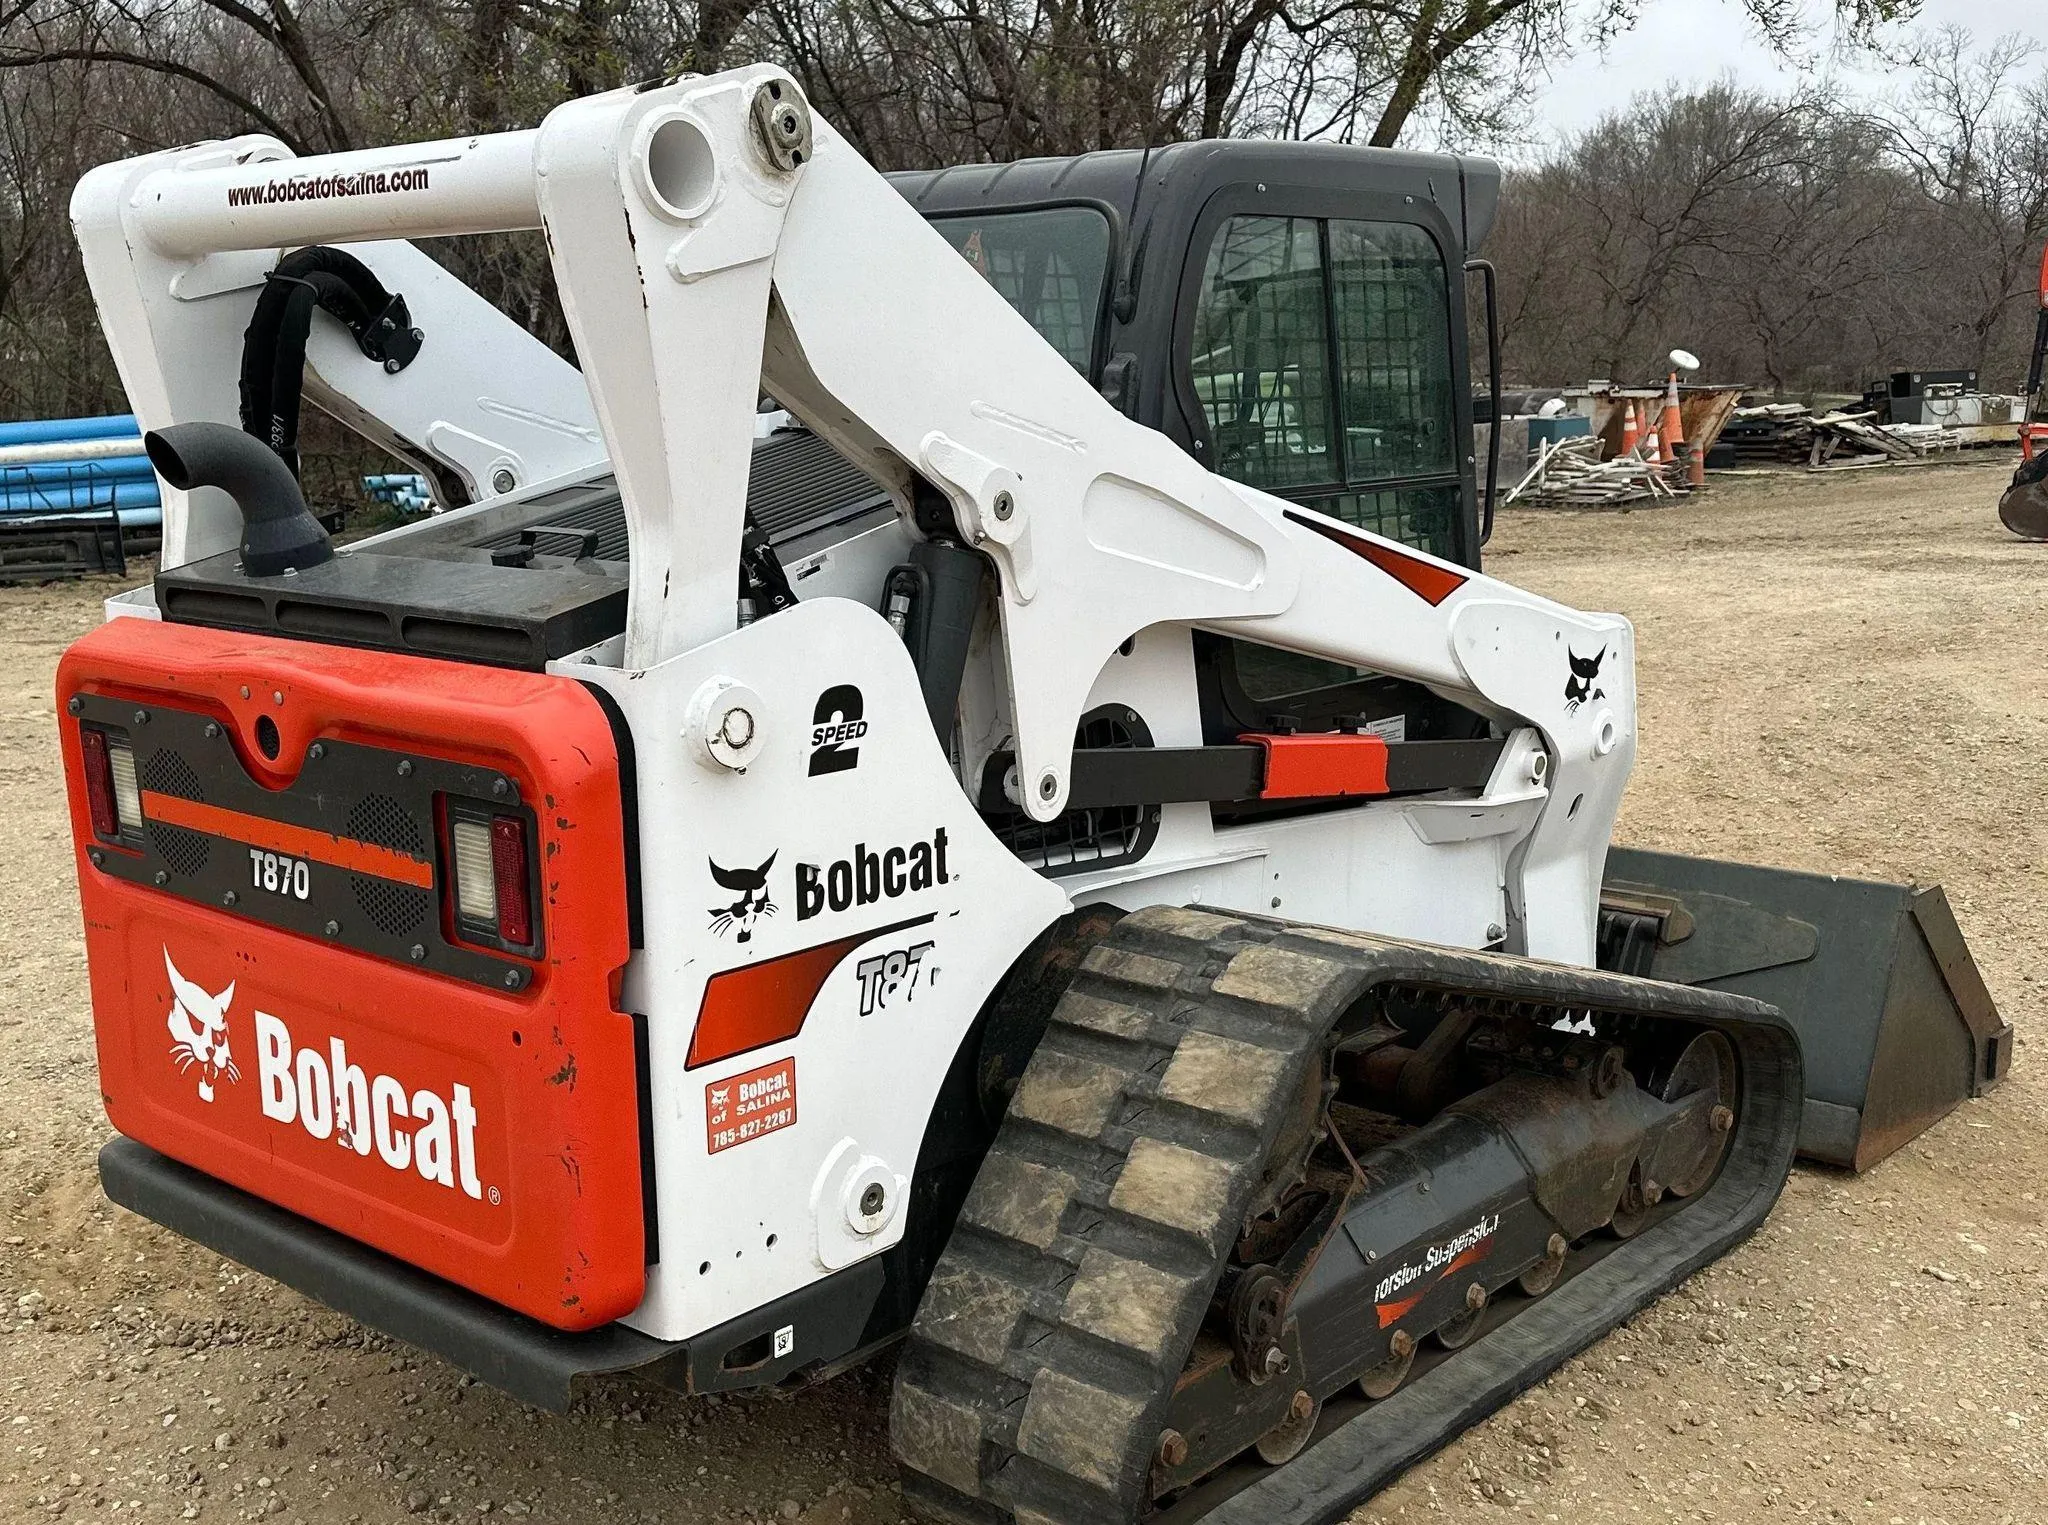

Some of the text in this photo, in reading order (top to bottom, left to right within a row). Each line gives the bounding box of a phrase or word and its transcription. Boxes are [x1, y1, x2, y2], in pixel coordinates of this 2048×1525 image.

[228, 168, 429, 206] www.bobcatofsalina.com
[808, 684, 864, 777] 2
[811, 720, 868, 746] SPEED
[250, 848, 310, 900] T870
[795, 826, 949, 922] Bobcat
[856, 940, 941, 1017] T87
[254, 1009, 483, 1201] Bobcat
[711, 1088, 792, 1125] of SALINA
[739, 1070, 788, 1102] Bobcat
[713, 1107, 793, 1149] 785-827-2287
